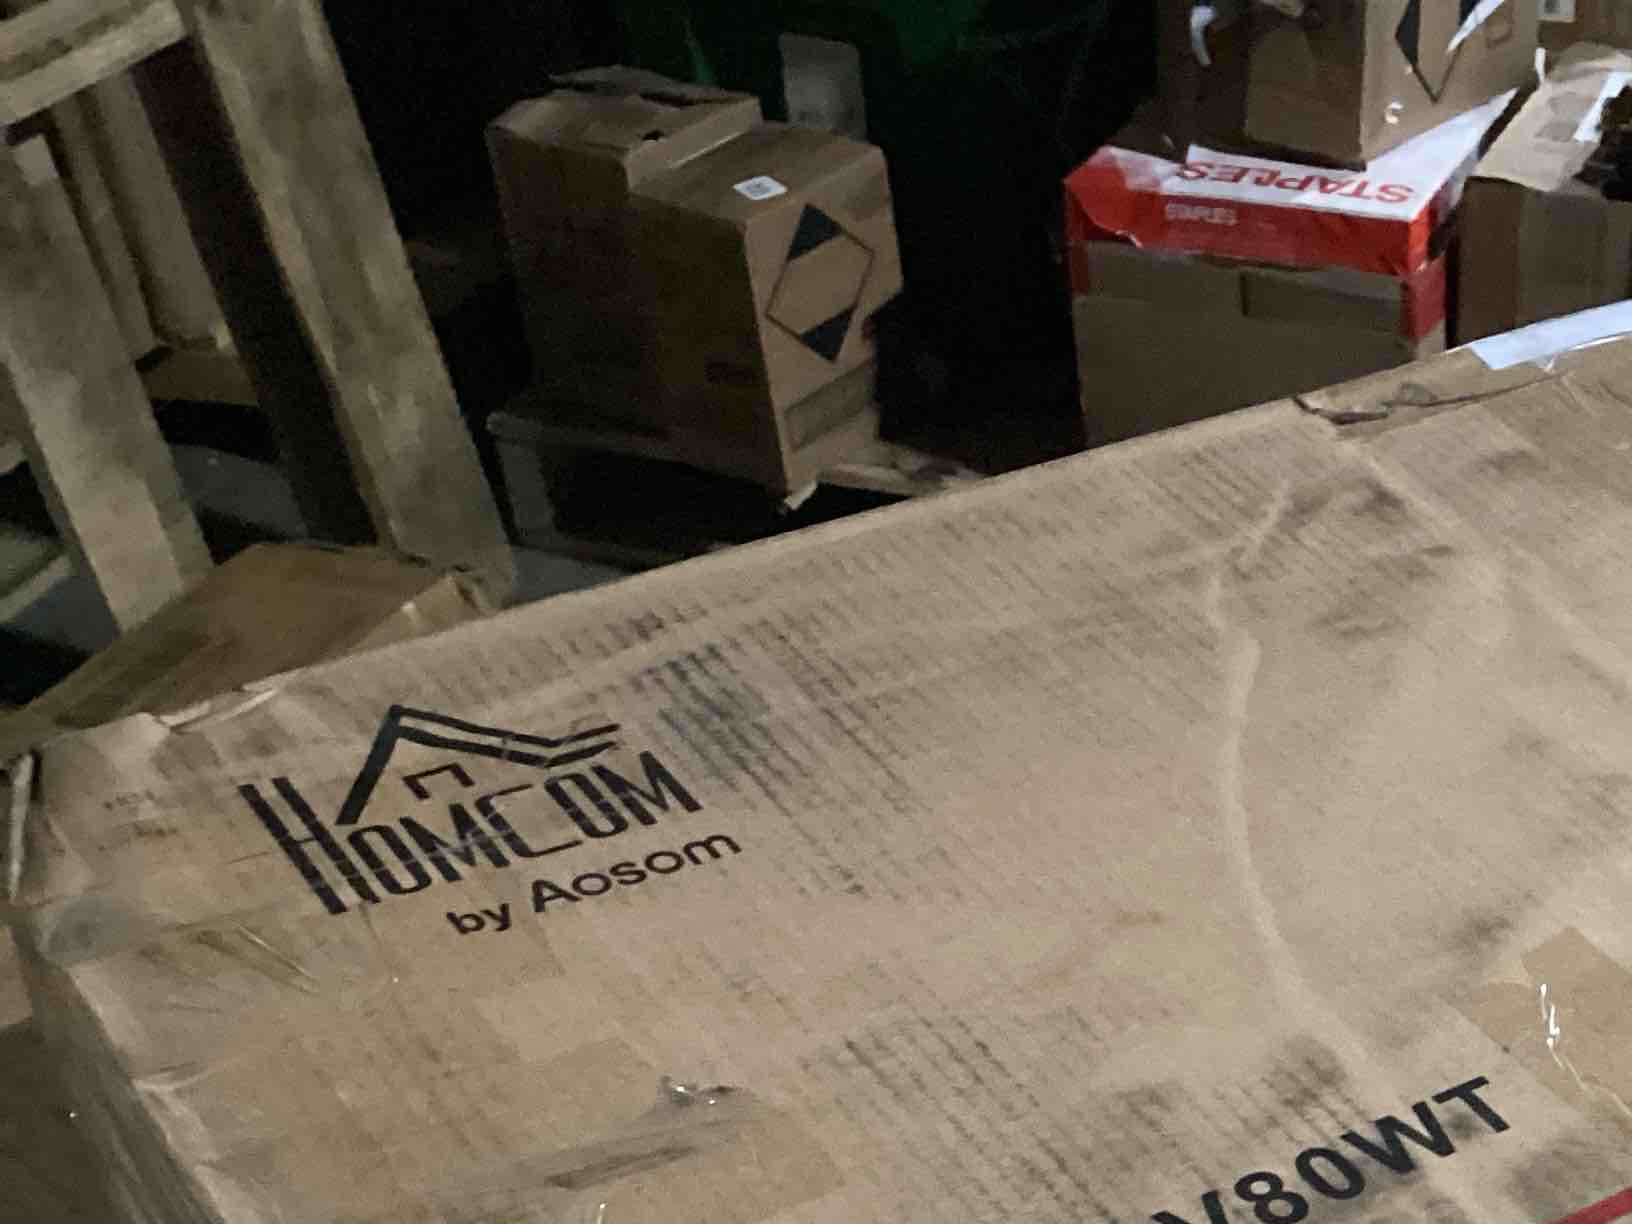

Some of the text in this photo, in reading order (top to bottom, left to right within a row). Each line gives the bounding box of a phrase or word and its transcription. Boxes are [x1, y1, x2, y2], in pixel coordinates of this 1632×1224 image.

[1176, 161, 1414, 202] STAPLES
[237, 750, 701, 916] HOMCOM
[446, 831, 743, 936] by Aosom
